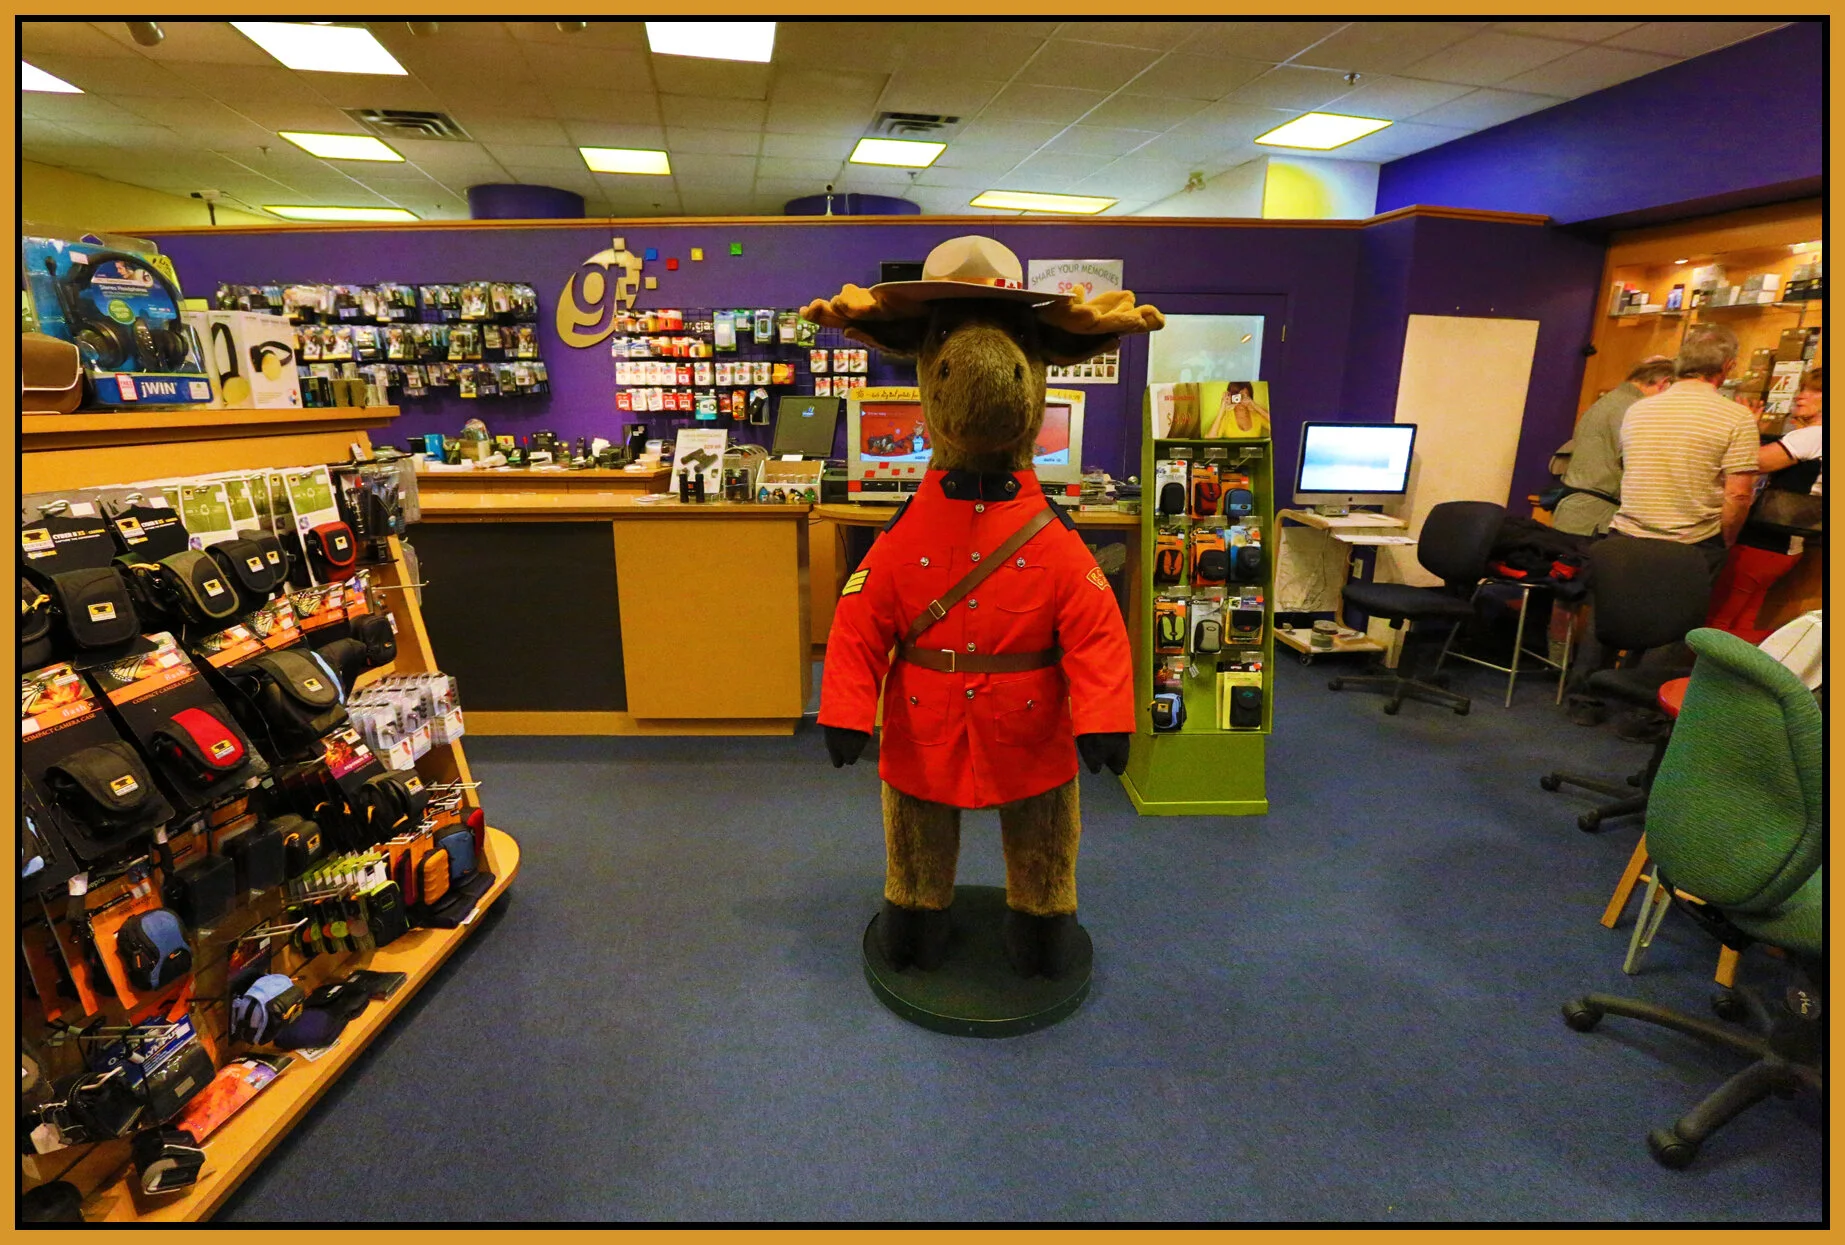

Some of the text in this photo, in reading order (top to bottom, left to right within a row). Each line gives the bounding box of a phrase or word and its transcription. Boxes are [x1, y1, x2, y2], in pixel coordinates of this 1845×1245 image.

[1031, 263, 1119, 286] SHARE YOUR MEMORIES
[141, 381, 177, 398] jWIN
[132, 676, 195, 705] COMPACT CAMERA CASE
[62, 704, 88, 718] flash
[22, 713, 97, 744] COMPACT CAMERA CASE
